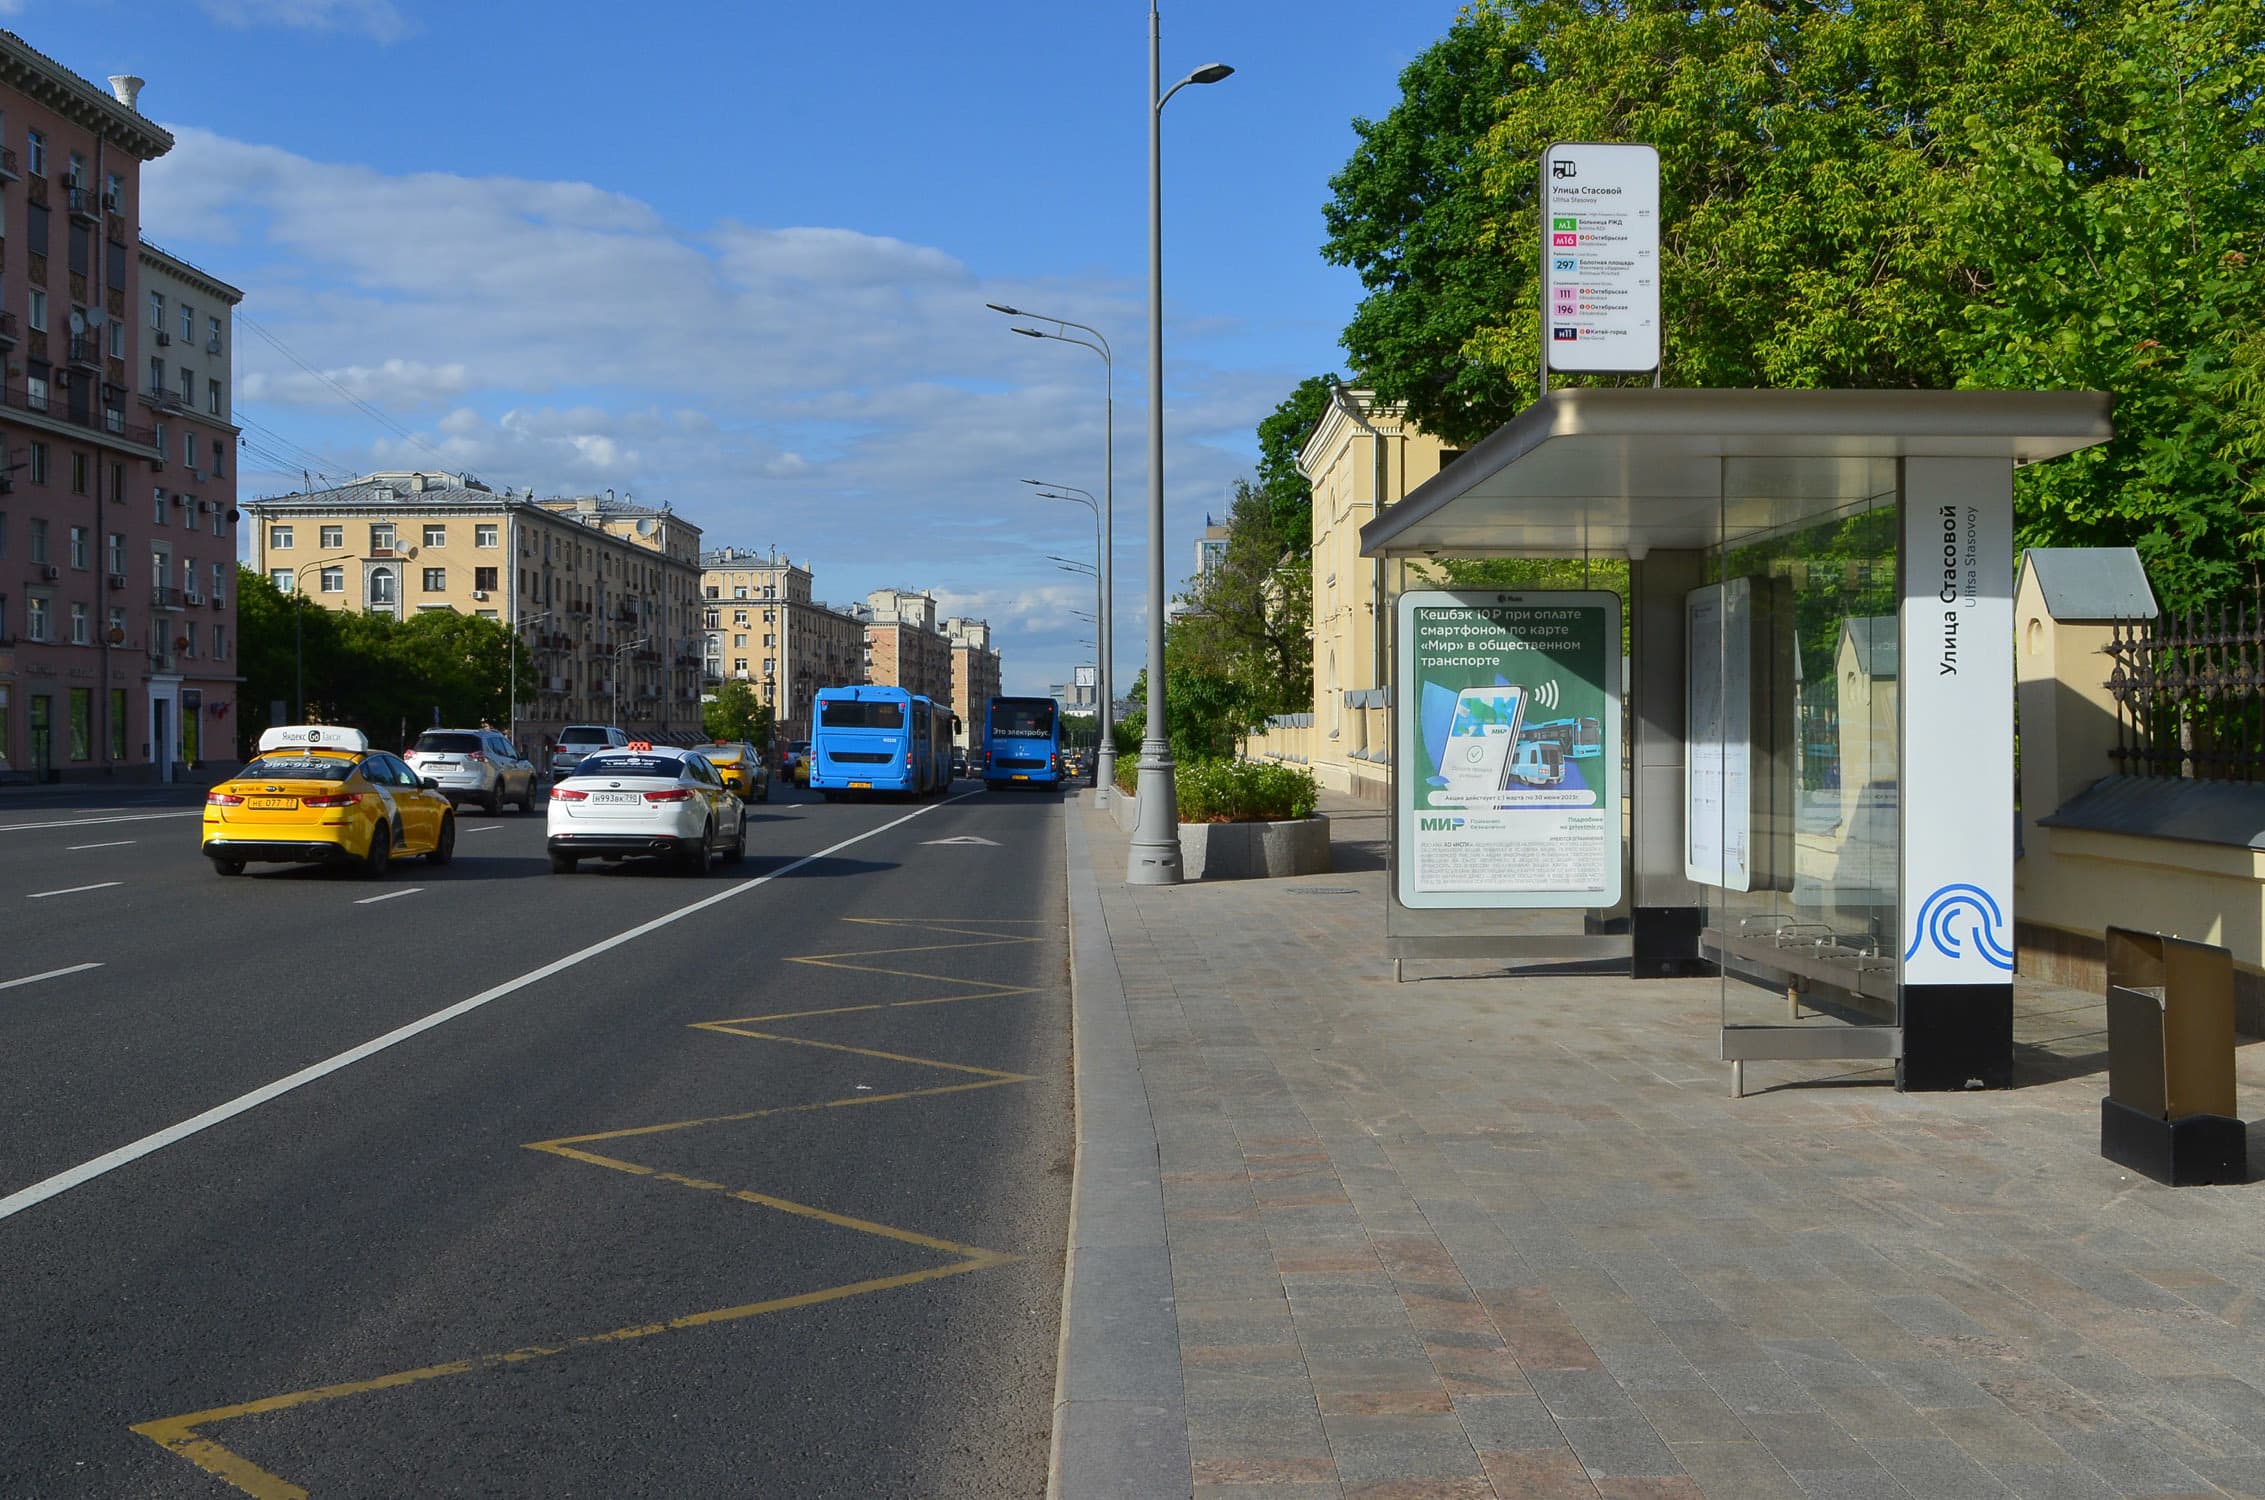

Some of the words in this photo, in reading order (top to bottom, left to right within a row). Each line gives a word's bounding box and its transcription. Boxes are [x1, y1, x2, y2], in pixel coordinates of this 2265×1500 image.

[1553, 186, 1579, 195] Улица
[1582, 186, 1622, 195] Стасовой
[1556, 260, 1574, 270] 297
[1560, 290, 1570, 298] 111
[1558, 306, 1573, 314] 196
[1964, 506, 1979, 566] Stasovoy
[1939, 505, 1957, 604] Стасовой
[1964, 570, 1977, 608] Ulitsa
[1420, 609, 1473, 620] Кешбэк
[1505, 611, 1531, 621] при
[1534, 610, 1582, 619] оплате
[1420, 624, 1506, 637] смартфоном
[1510, 626, 1526, 635] по
[1530, 626, 1569, 637] карте
[1420, 640, 1464, 652] «Мир»
[1467, 641, 1476, 650] в
[1479, 640, 1581, 652] общественном
[1940, 611, 1959, 675] Улица
[1420, 657, 1500, 668] транспорте
[282, 731, 307, 742] Яндекс
[322, 732, 341, 741] Такси
[1421, 818, 1465, 831] МИР
